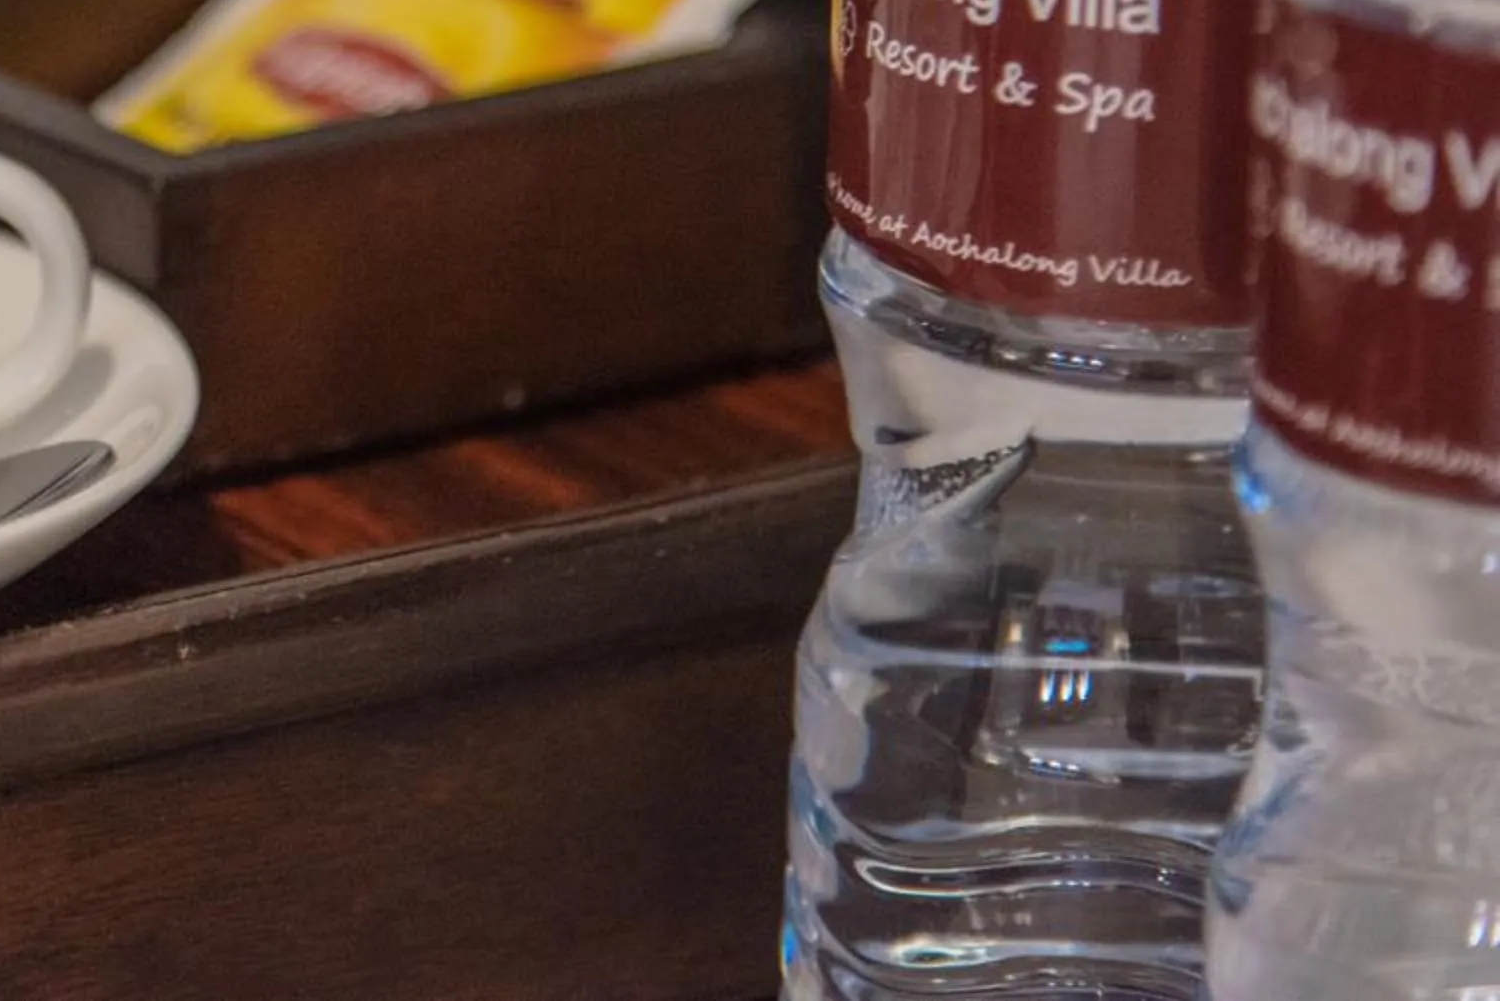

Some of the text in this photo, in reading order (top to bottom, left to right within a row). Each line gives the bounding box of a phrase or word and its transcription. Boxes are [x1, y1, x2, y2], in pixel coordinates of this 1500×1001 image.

[865, 20, 1156, 133] Resort & Spa
[879, 213, 909, 239] at
[910, 220, 1079, 287] Aochalong
[1088, 254, 1193, 288] Villa
